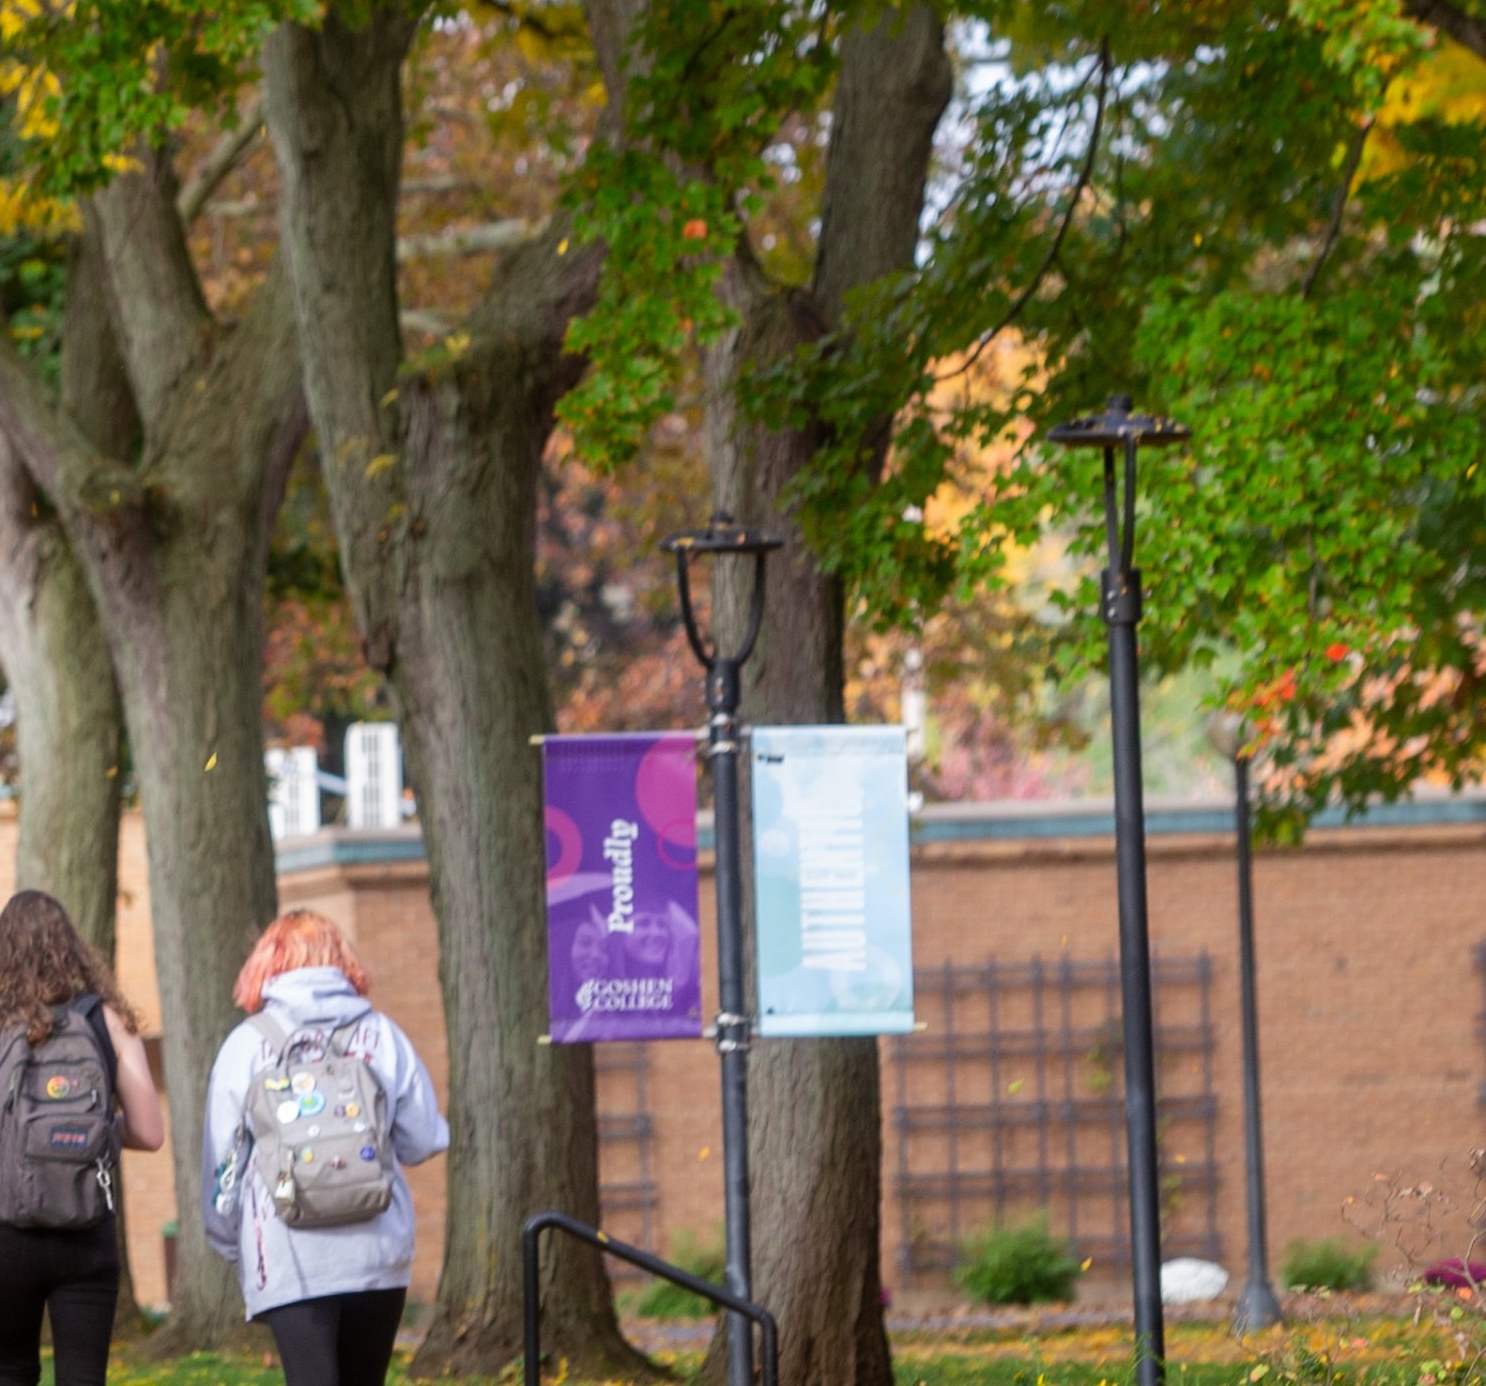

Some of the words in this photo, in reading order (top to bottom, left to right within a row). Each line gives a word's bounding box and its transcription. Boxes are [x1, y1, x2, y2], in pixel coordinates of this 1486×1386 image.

[603, 818, 638, 934] Proudly
[799, 798, 866, 971] AUTHENTIC
[593, 978, 674, 994] GOSHEN
[593, 994, 674, 1010] COLLEGE
